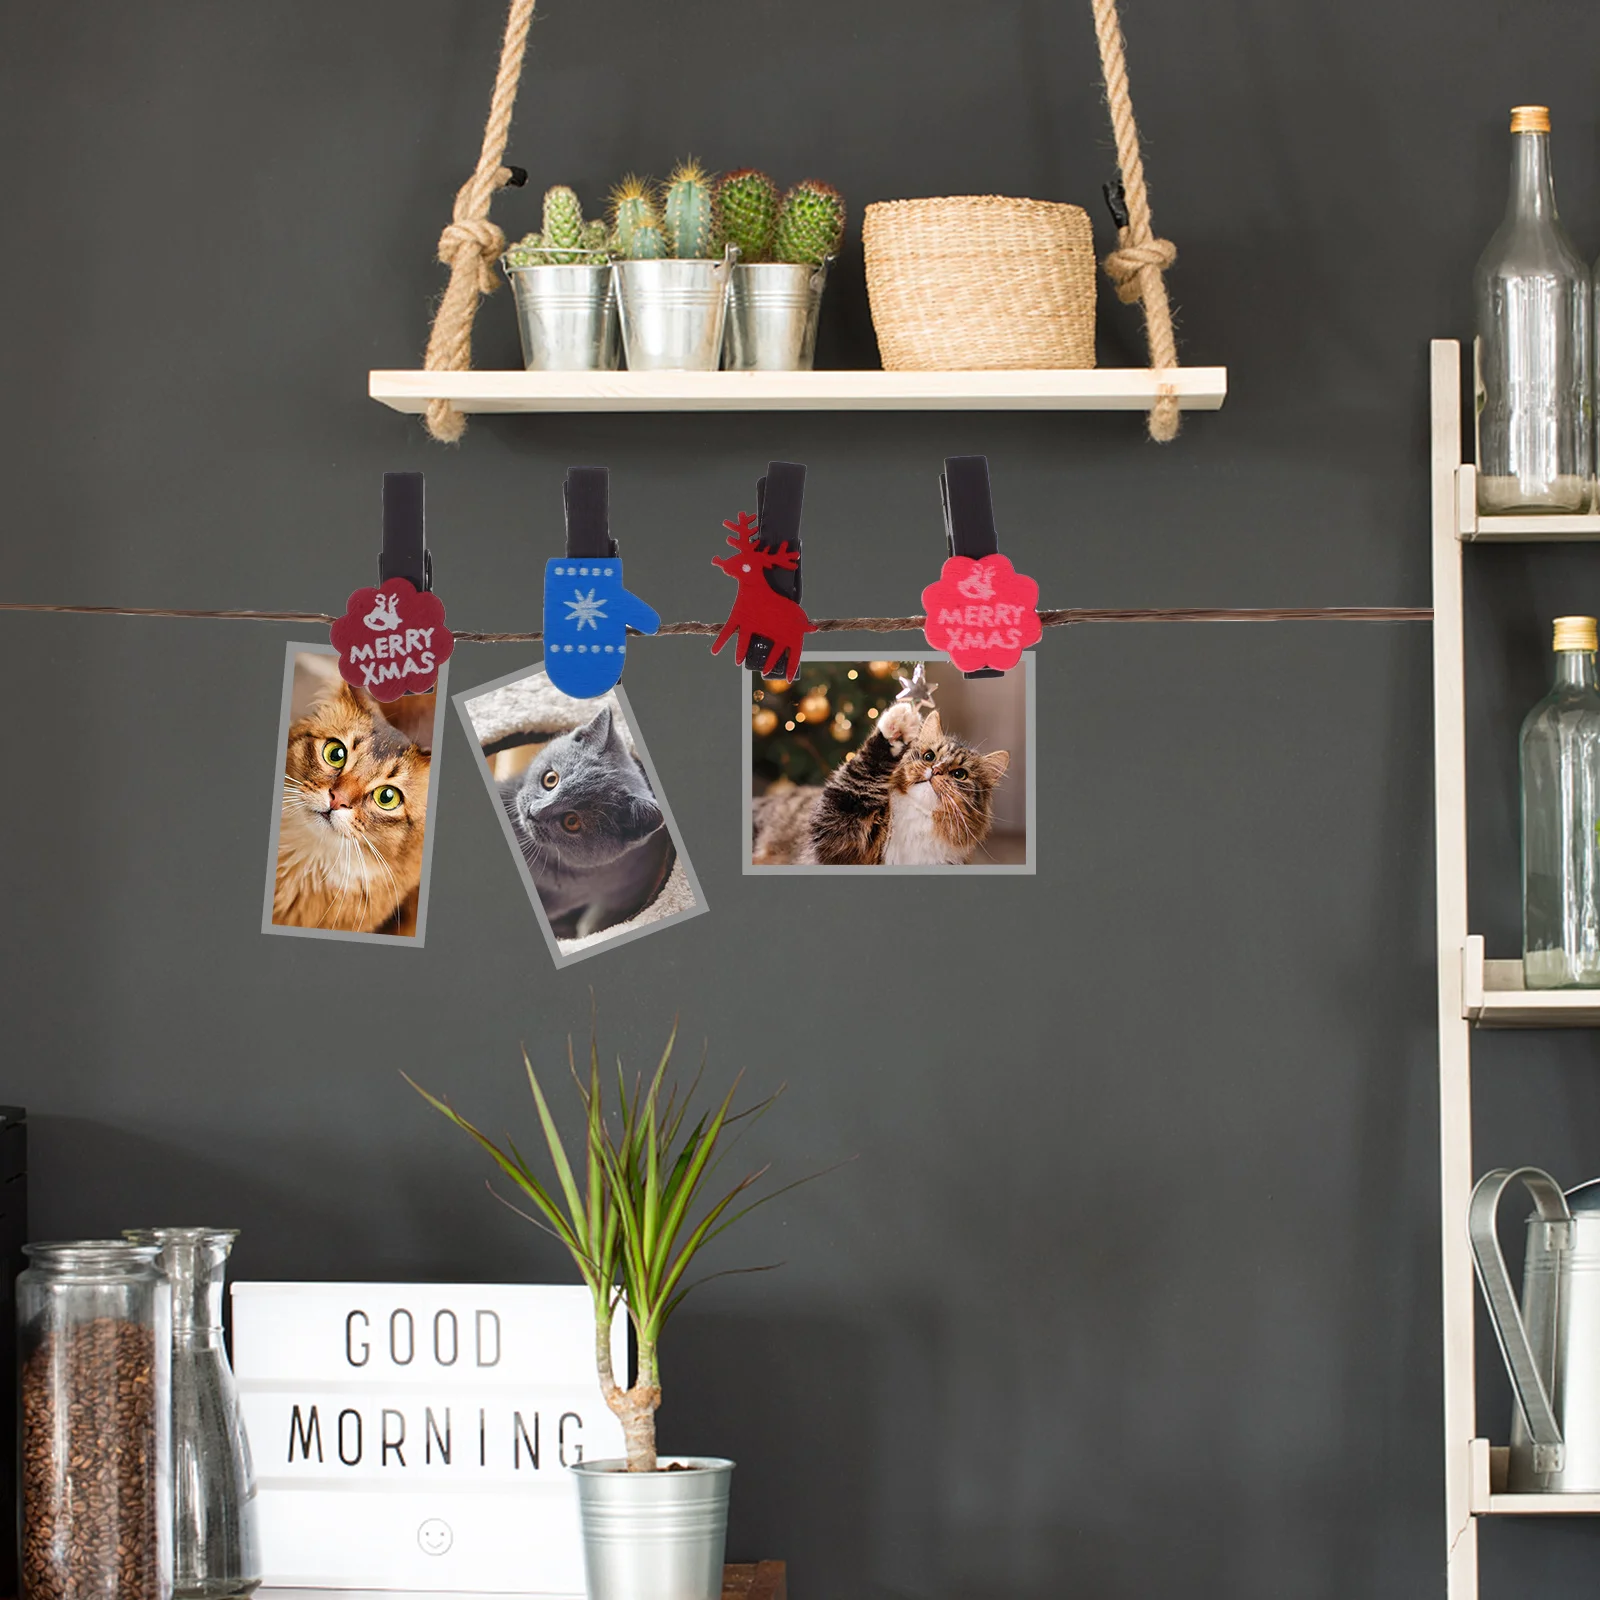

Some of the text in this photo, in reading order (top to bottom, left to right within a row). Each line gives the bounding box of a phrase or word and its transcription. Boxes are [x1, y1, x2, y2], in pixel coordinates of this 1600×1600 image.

[937, 603, 1025, 627] MERRY
[349, 628, 435, 664] MERRY
[947, 627, 1022, 651] XMAS
[360, 651, 435, 687] XMAS
[345, 1309, 501, 1367] GOOD
[287, 1405, 584, 1469] MORNING
